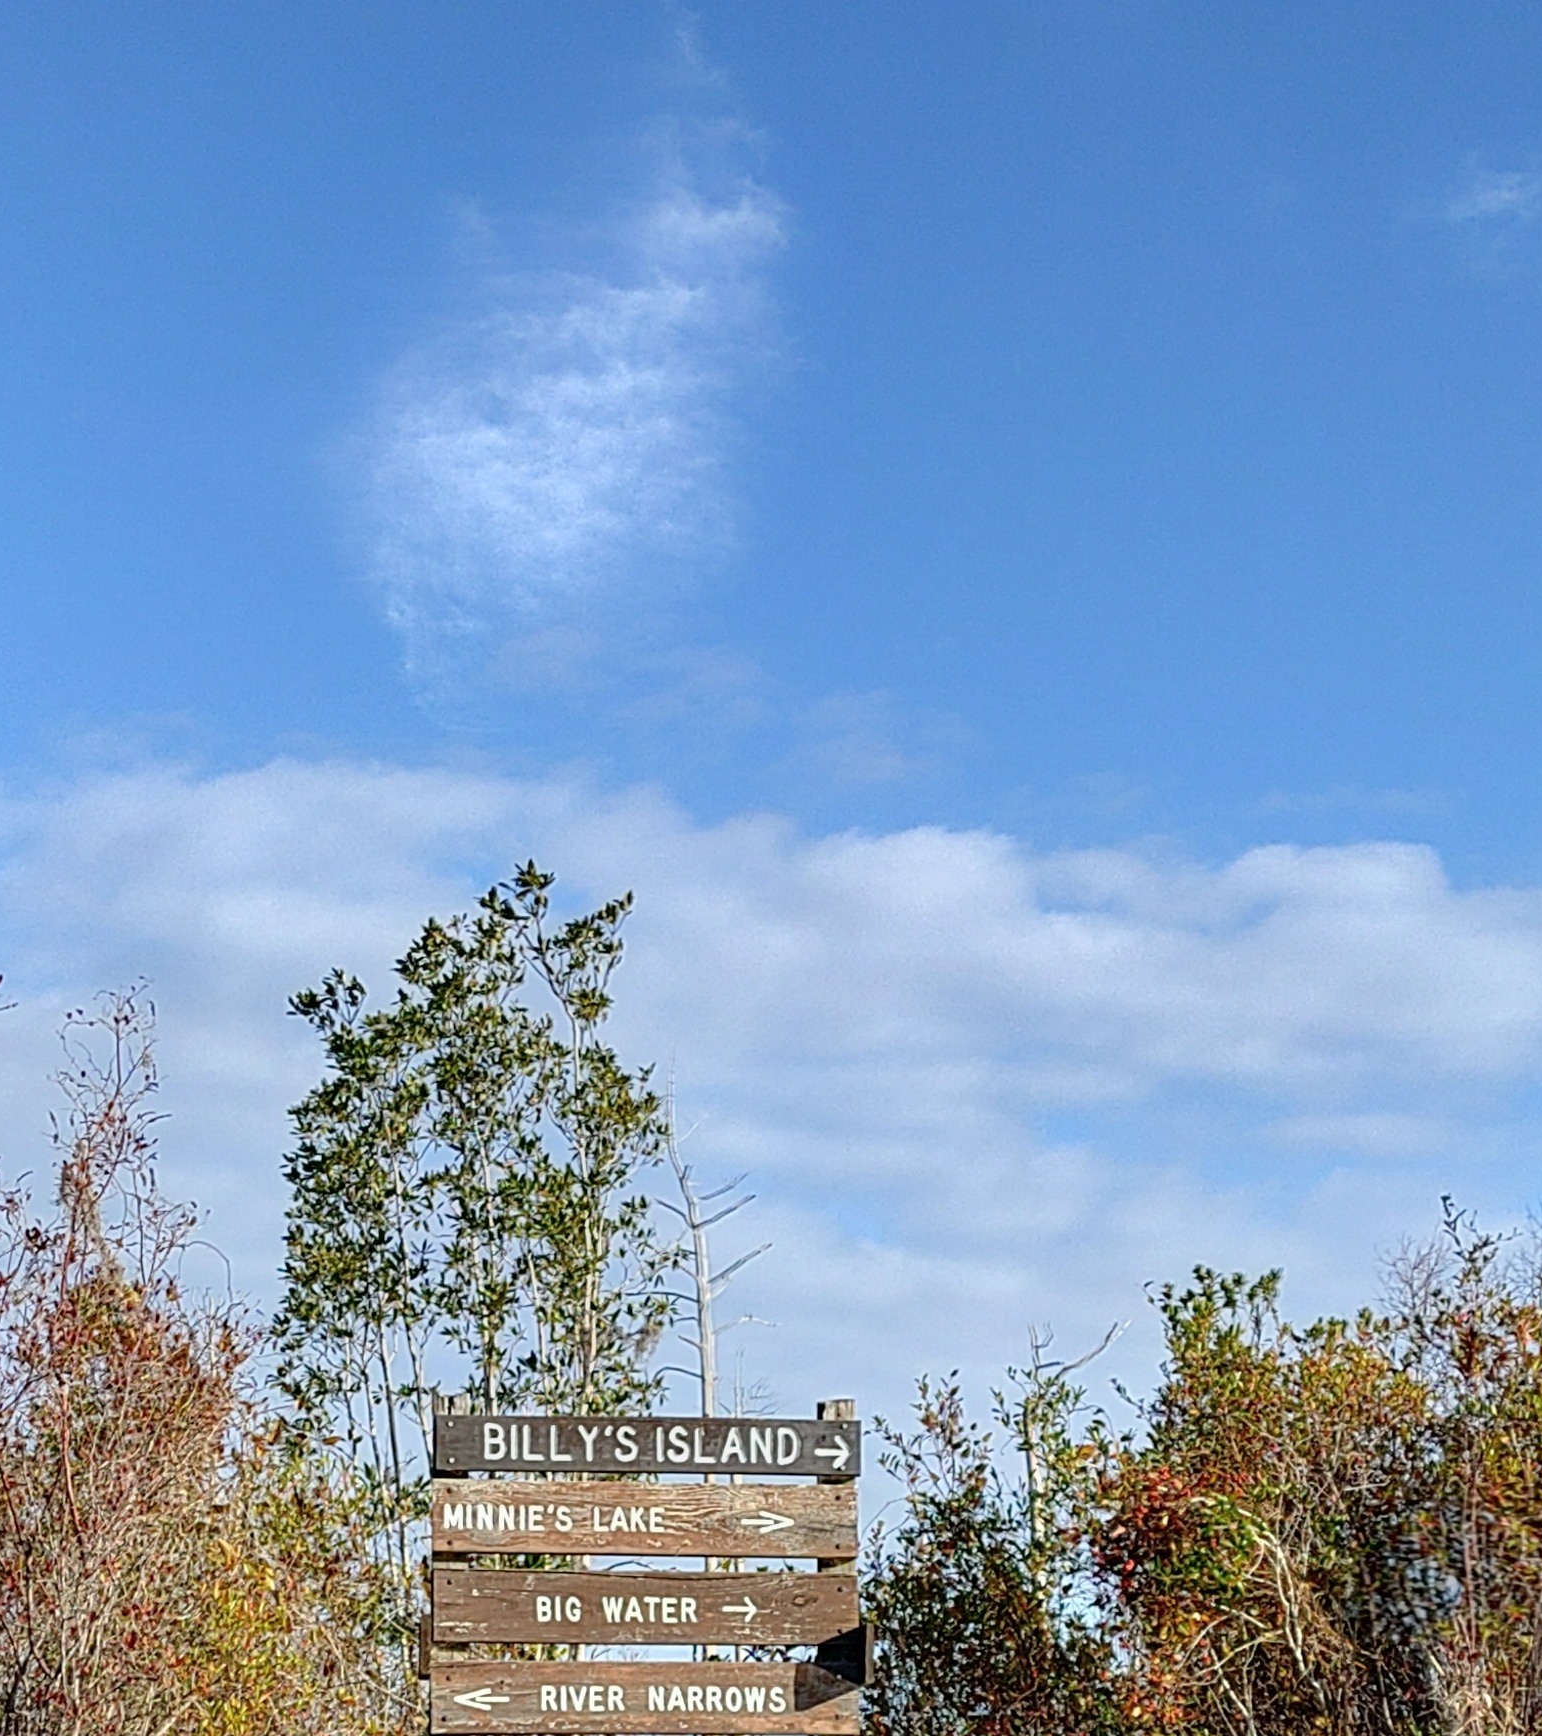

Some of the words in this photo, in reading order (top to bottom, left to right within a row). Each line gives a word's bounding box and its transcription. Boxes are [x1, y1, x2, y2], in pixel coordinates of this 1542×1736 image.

[482, 1421, 639, 1463] BILLY'S
[656, 1425, 801, 1466] ISLAND
[443, 1503, 573, 1532] MINNIE'S
[593, 1507, 666, 1533] LAKE
[536, 1596, 582, 1623] BIG
[602, 1596, 698, 1623] WATER
[540, 1685, 625, 1711] RIVER
[648, 1685, 786, 1713] NARROWS
